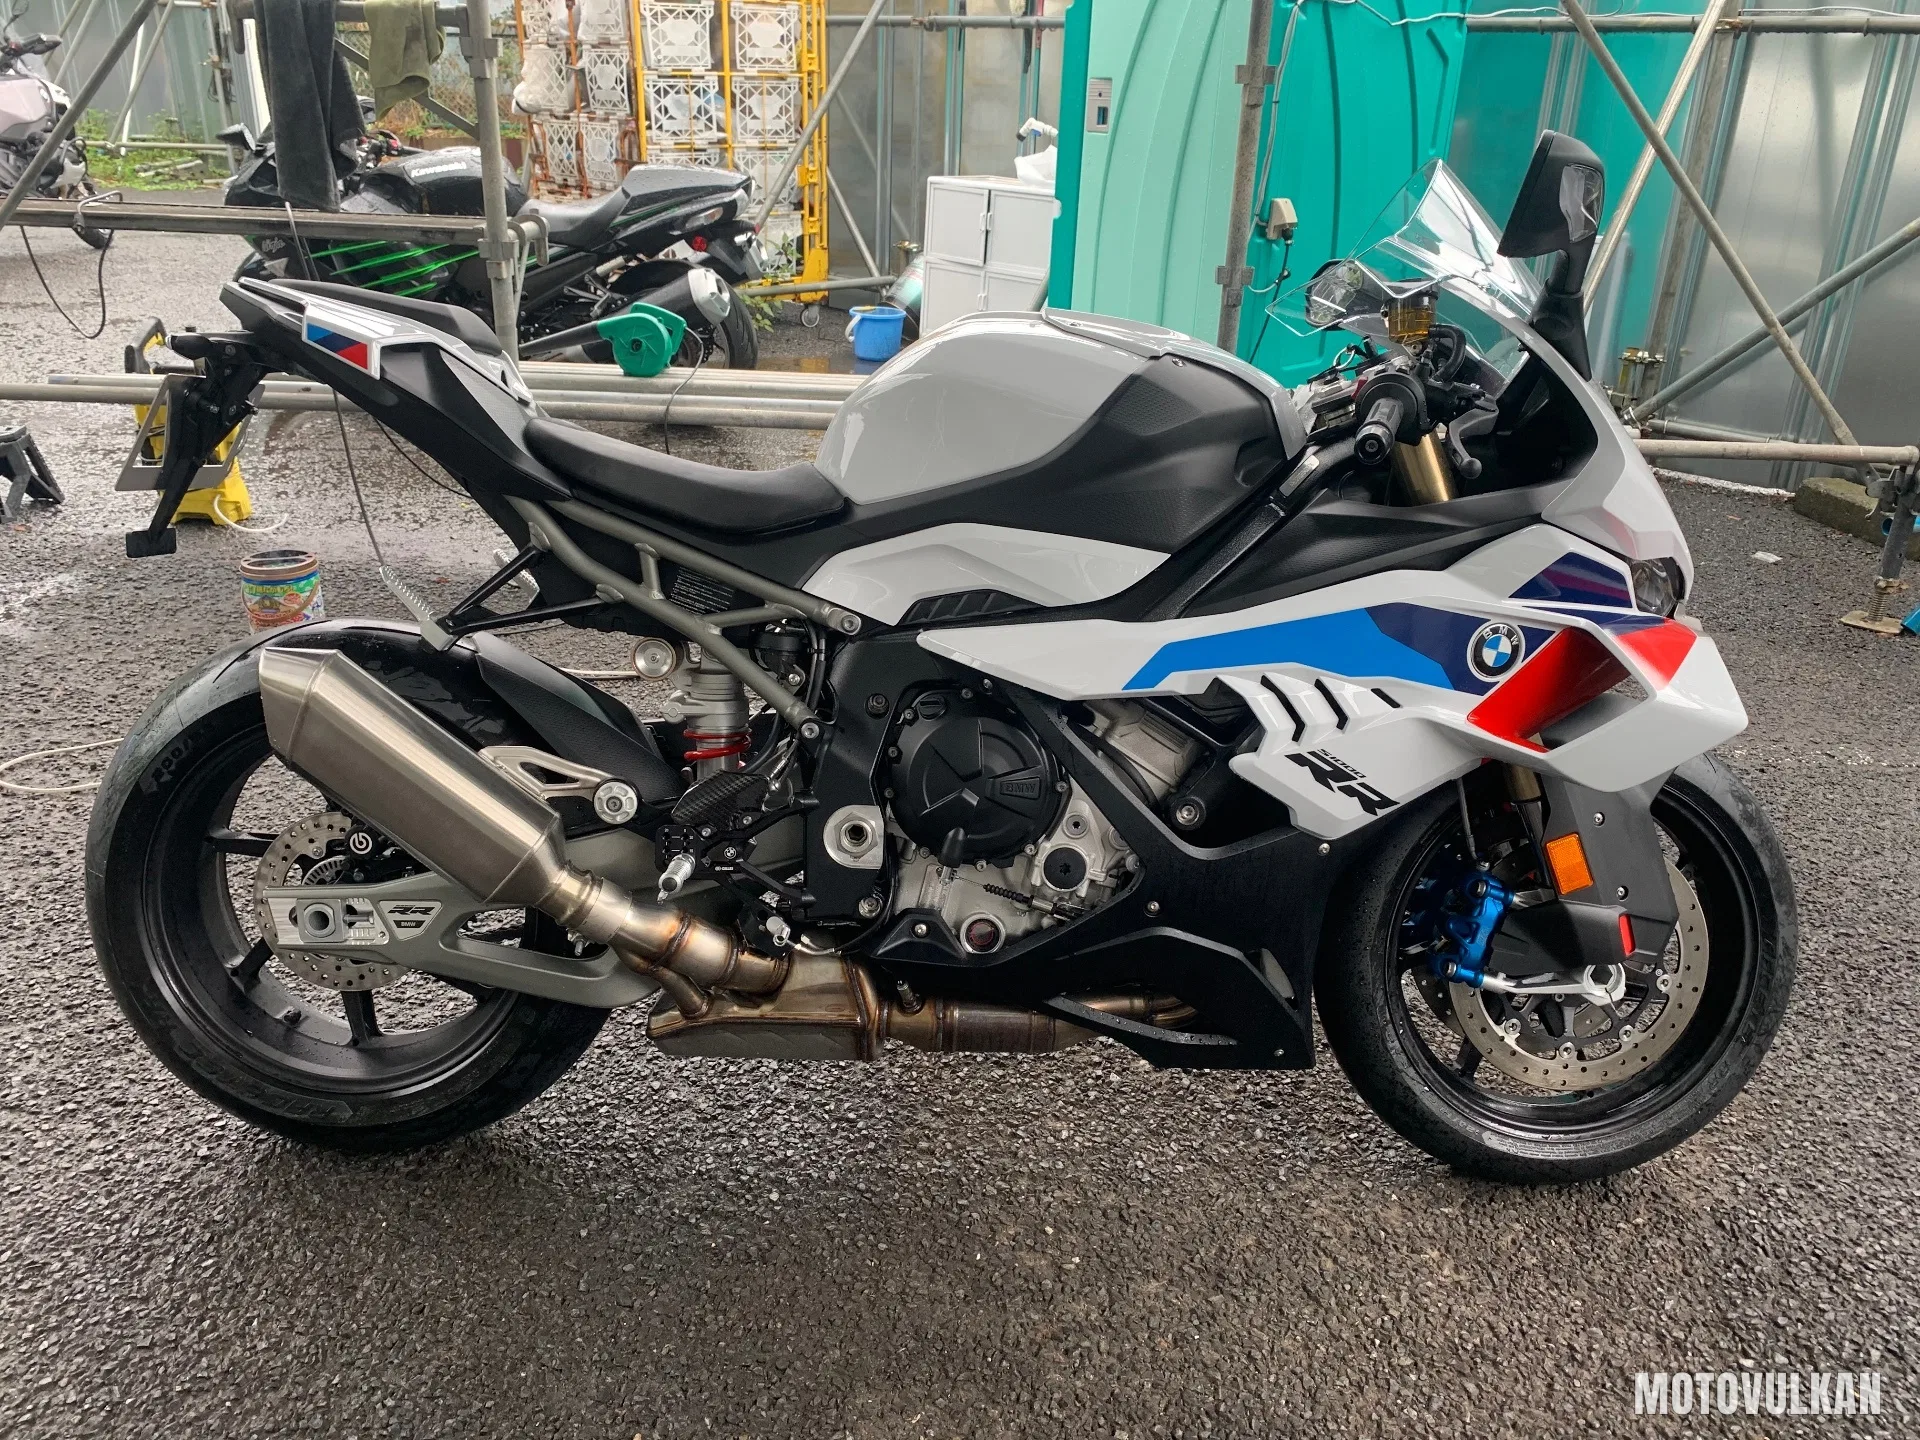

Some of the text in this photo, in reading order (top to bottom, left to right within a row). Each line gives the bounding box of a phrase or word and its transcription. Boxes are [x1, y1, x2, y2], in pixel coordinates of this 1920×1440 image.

[410, 161, 467, 178] Kawasaki
[1481, 625, 1520, 646] BMW
[1004, 782, 1037, 794] BMW
[1283, 750, 1401, 817] RR
[387, 906, 436, 916] RR
